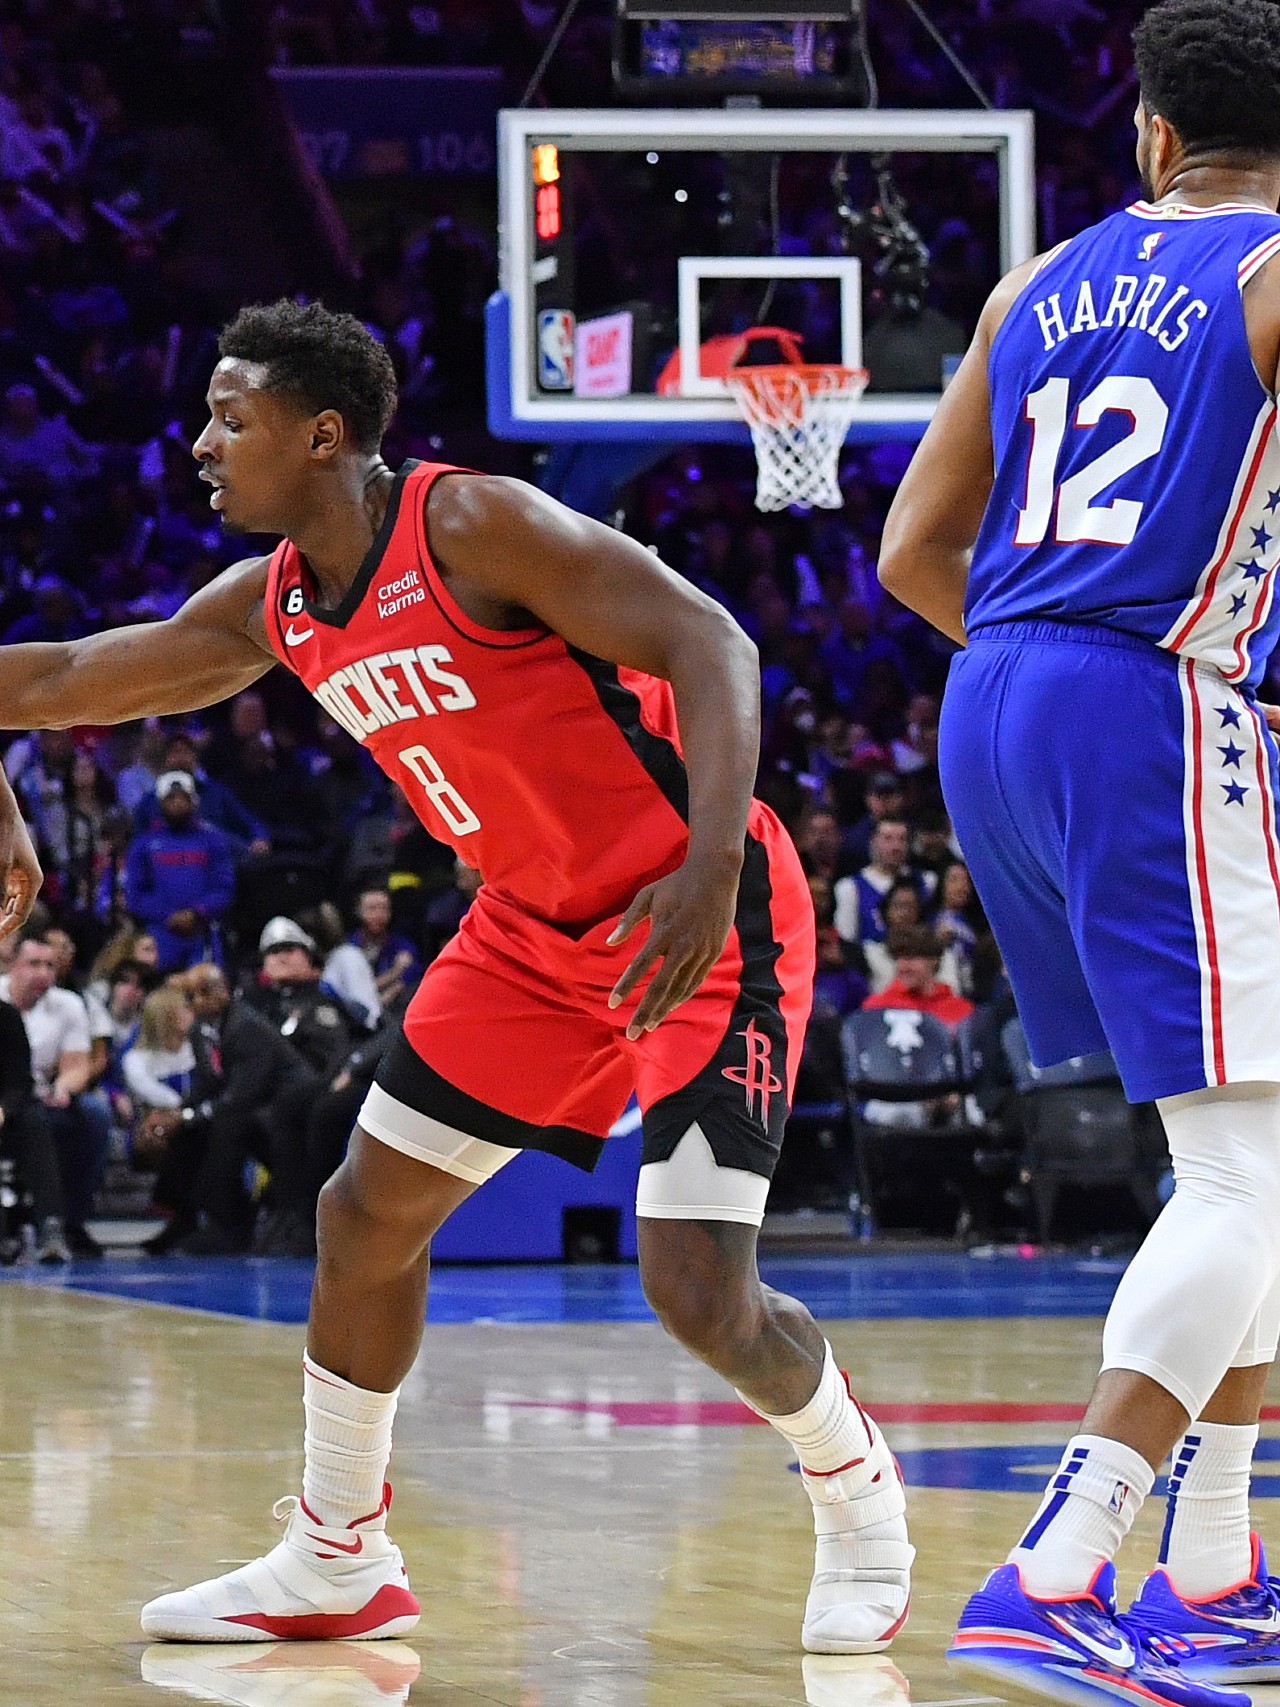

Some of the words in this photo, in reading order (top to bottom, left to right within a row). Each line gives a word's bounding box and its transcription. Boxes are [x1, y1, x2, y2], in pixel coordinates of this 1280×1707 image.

[1033, 274, 1208, 352] HARRIS
[1012, 375, 1169, 549] 12
[286, 588, 304, 614] 6
[377, 570, 420, 600] credit
[377, 588, 426, 620] karma
[312, 645, 477, 743] OCKETS
[398, 744, 481, 836] 8
